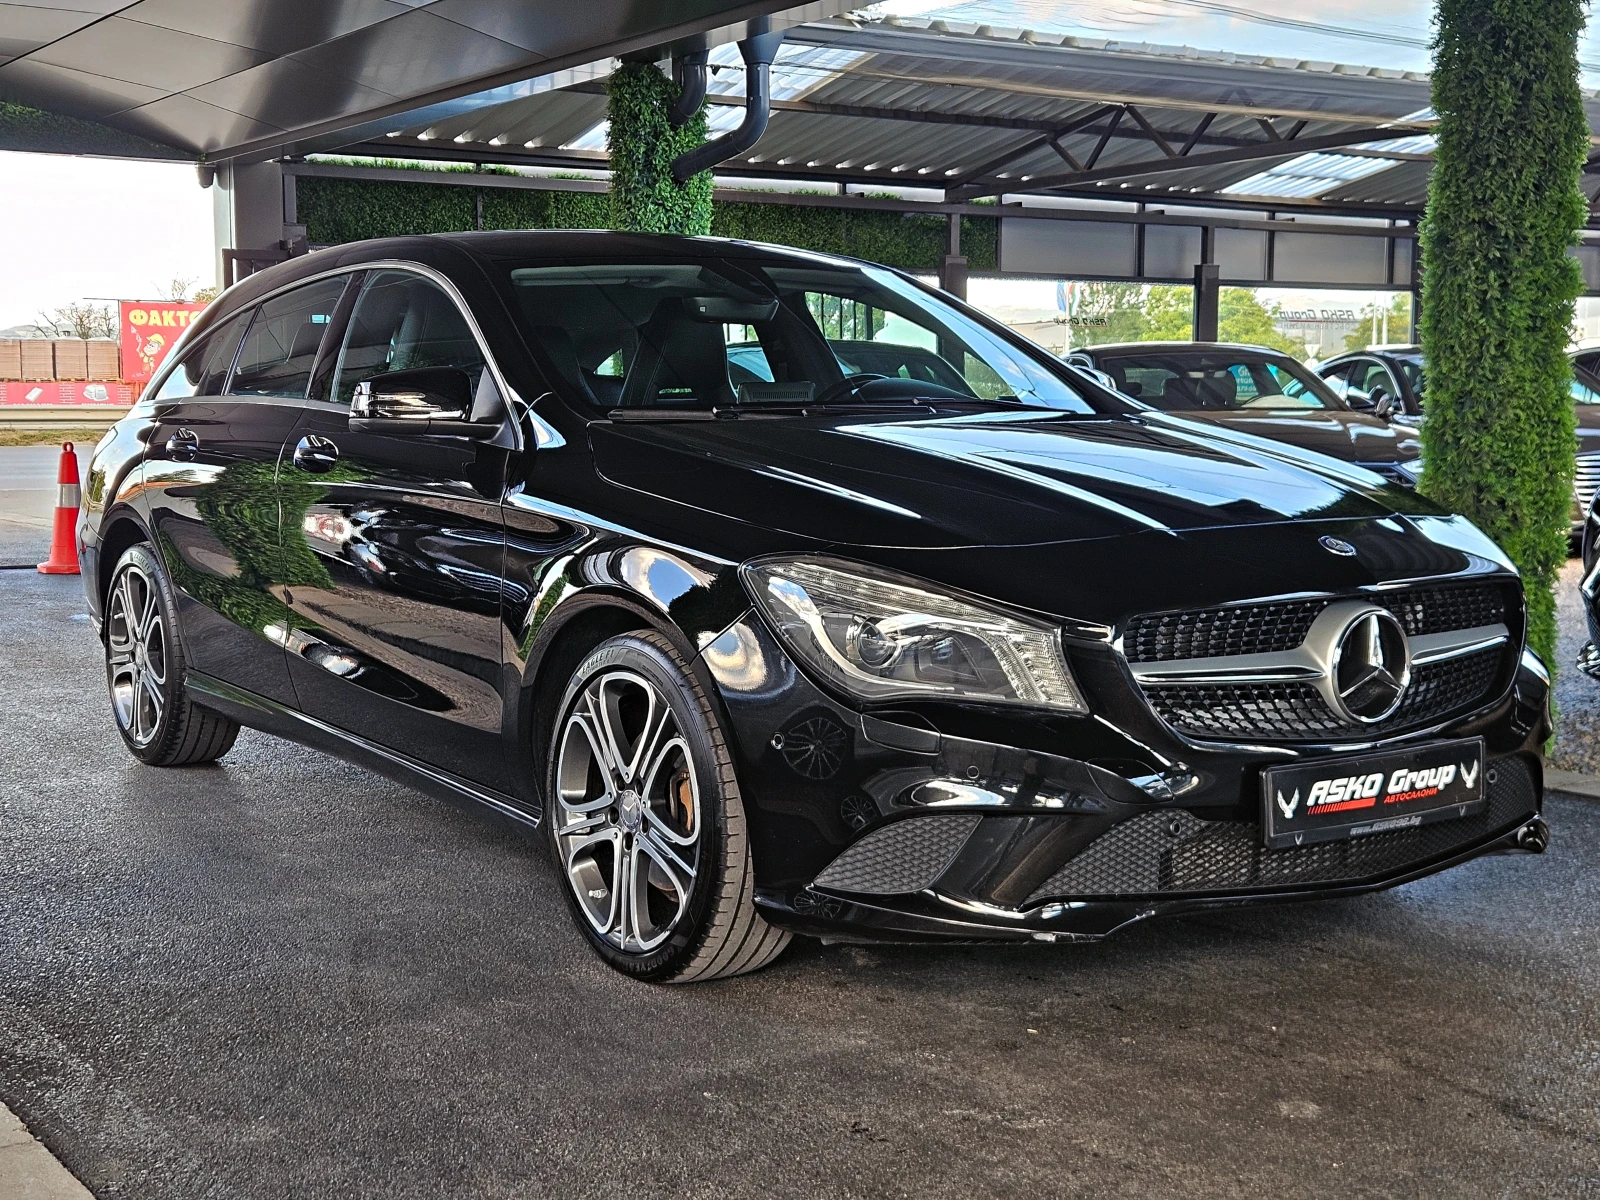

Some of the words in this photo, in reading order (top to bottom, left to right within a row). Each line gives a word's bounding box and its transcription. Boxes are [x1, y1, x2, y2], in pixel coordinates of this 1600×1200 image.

[1306, 772, 1384, 806] ASKO
[1387, 764, 1457, 792] Group
[1384, 788, 1438, 804] АВТОСАЛОНИ
